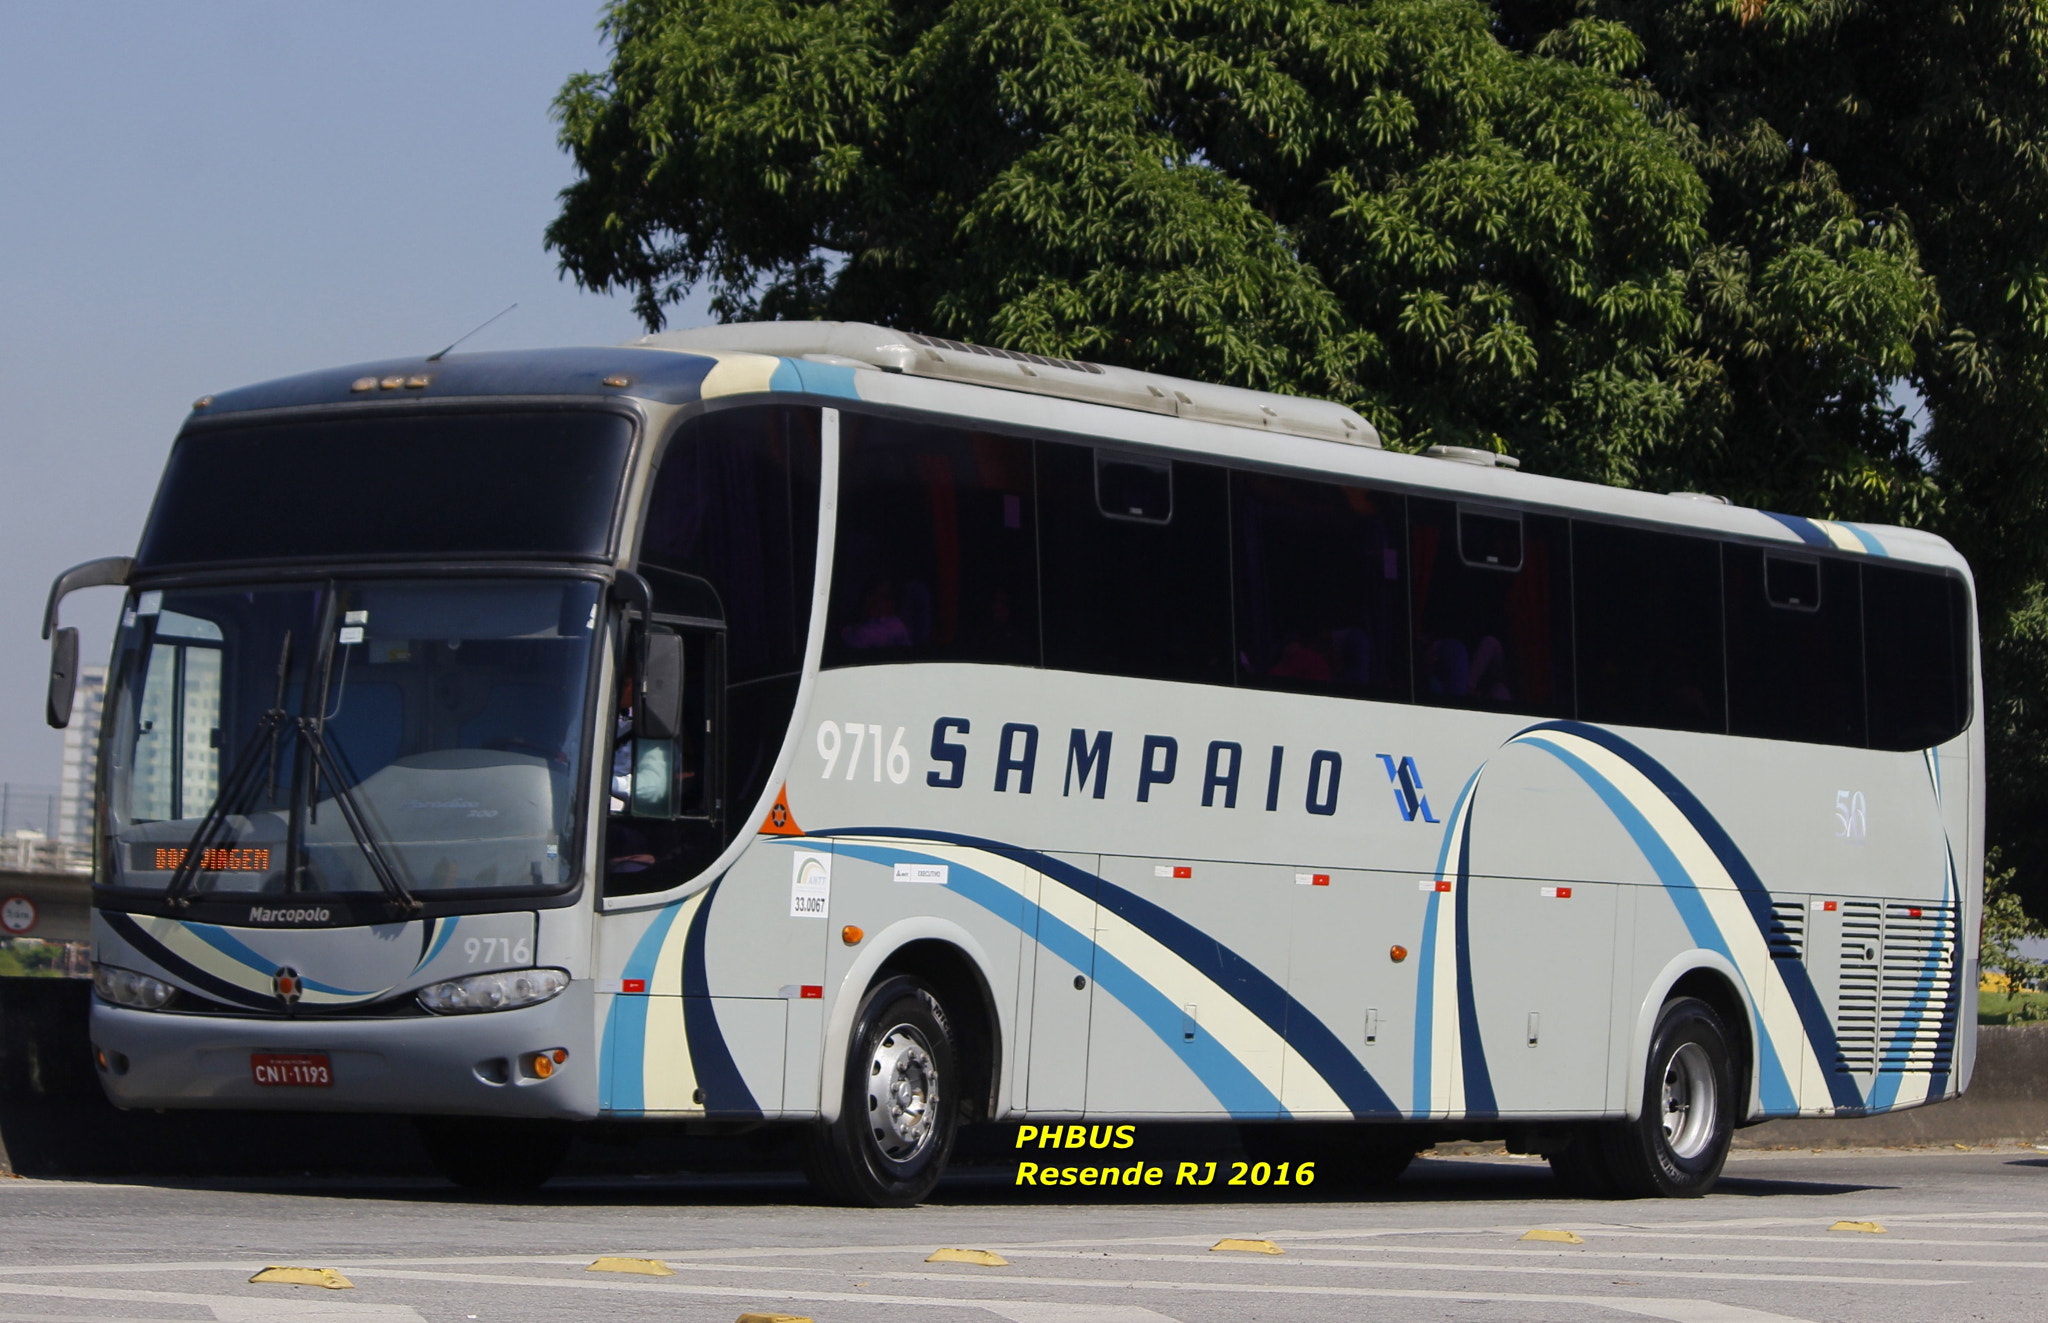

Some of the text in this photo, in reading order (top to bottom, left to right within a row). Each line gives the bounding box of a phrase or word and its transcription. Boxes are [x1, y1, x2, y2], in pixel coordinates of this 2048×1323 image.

[816, 720, 911, 784] 9716
[926, 715, 1343, 816] SAMPAIO
[249, 906, 330, 923] Marcopolo
[795, 896, 826, 913] 33.0067
[463, 937, 531, 964] 9716
